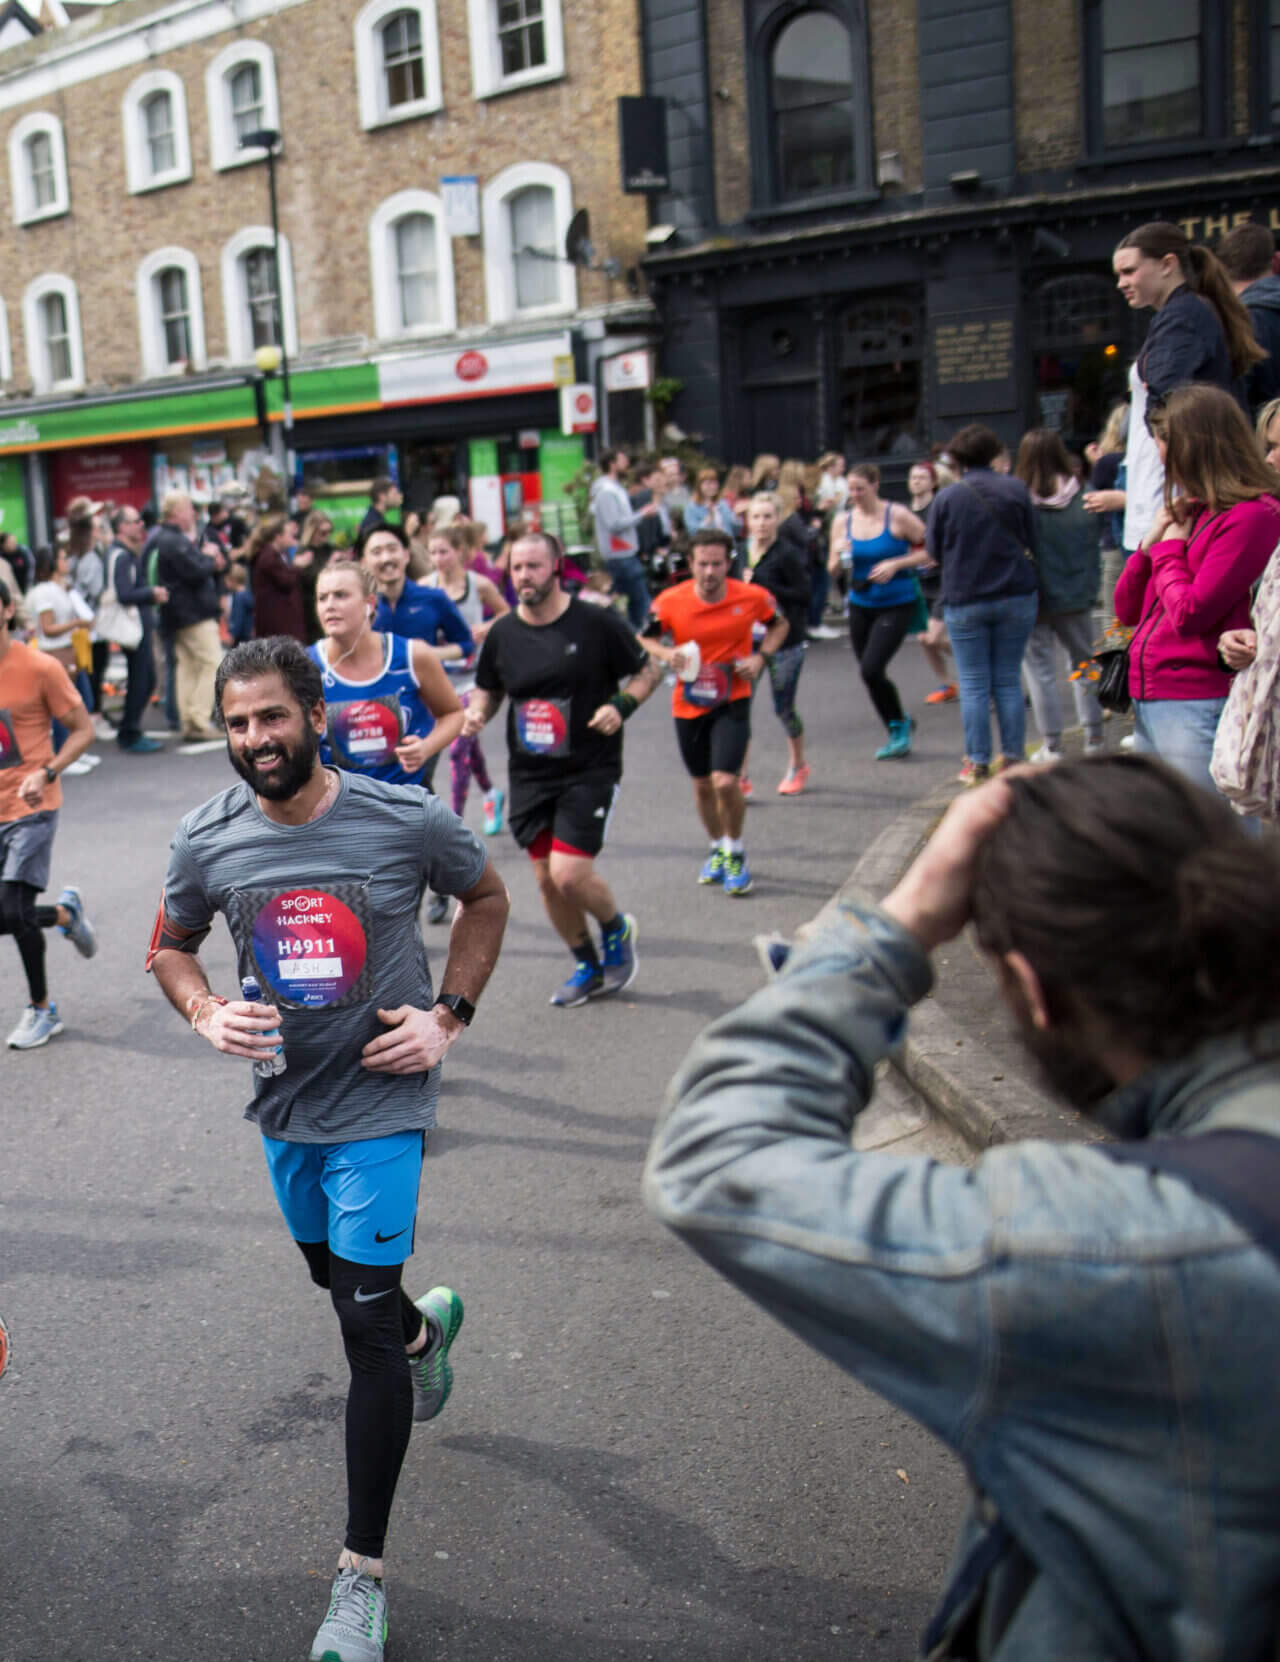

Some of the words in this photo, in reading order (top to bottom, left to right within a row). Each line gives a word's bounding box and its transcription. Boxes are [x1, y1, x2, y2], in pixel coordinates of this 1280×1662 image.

[281, 895, 324, 912] SPORT
[276, 913, 333, 926] HACKNEY
[278, 937, 335, 956] H4911
